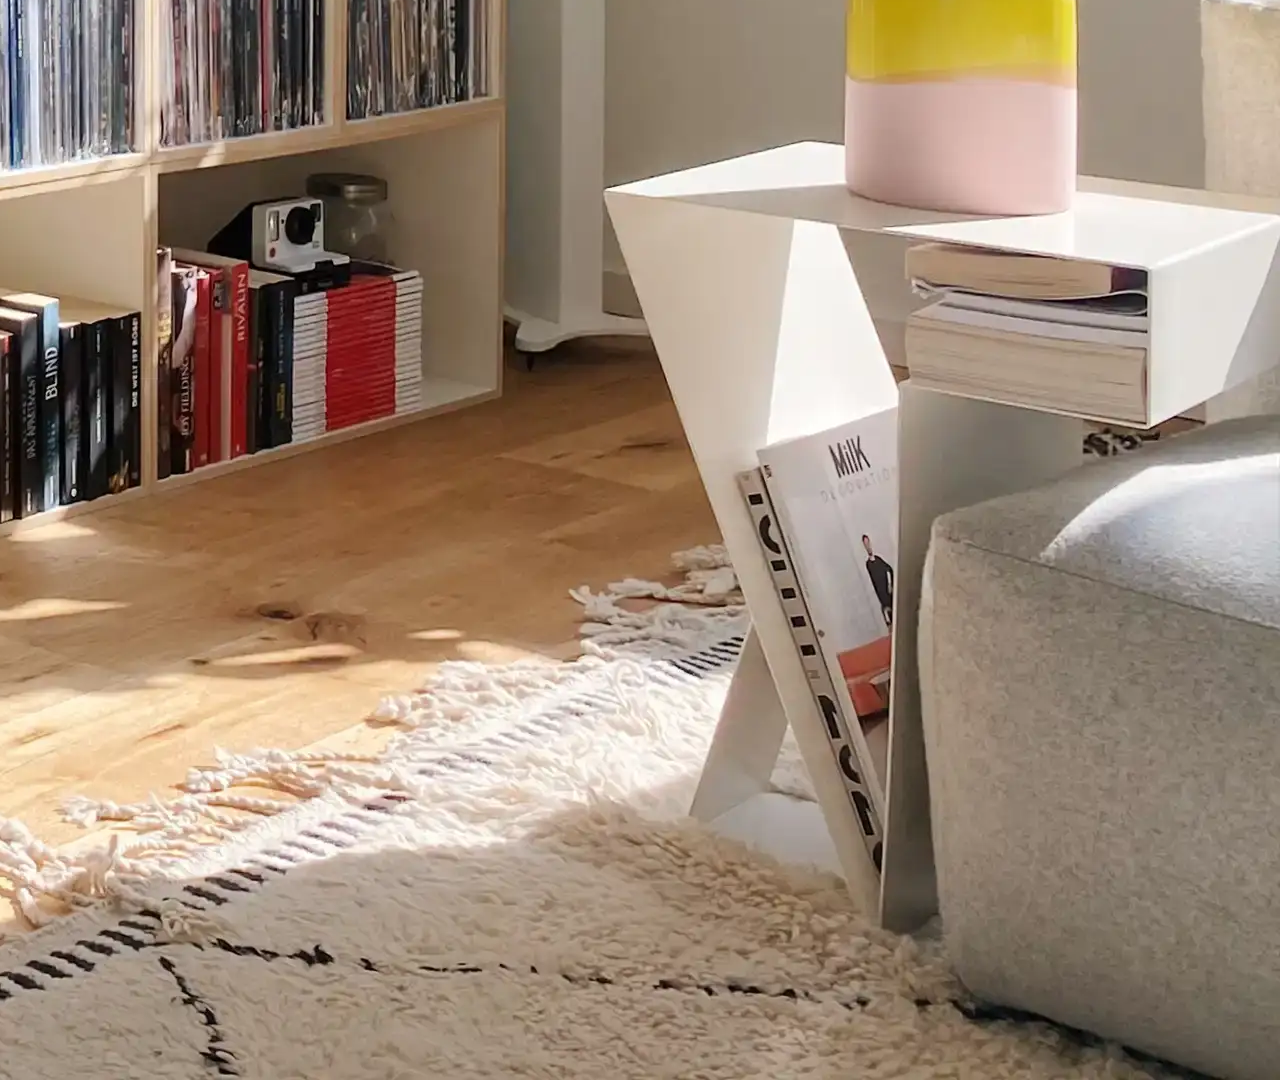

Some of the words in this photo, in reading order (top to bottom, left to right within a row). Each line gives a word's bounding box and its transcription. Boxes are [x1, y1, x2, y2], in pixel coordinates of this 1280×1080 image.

[44, 346, 59, 400] BLIND
[180, 356, 191, 412] FIELDING
[180, 413, 190, 436] JOY
